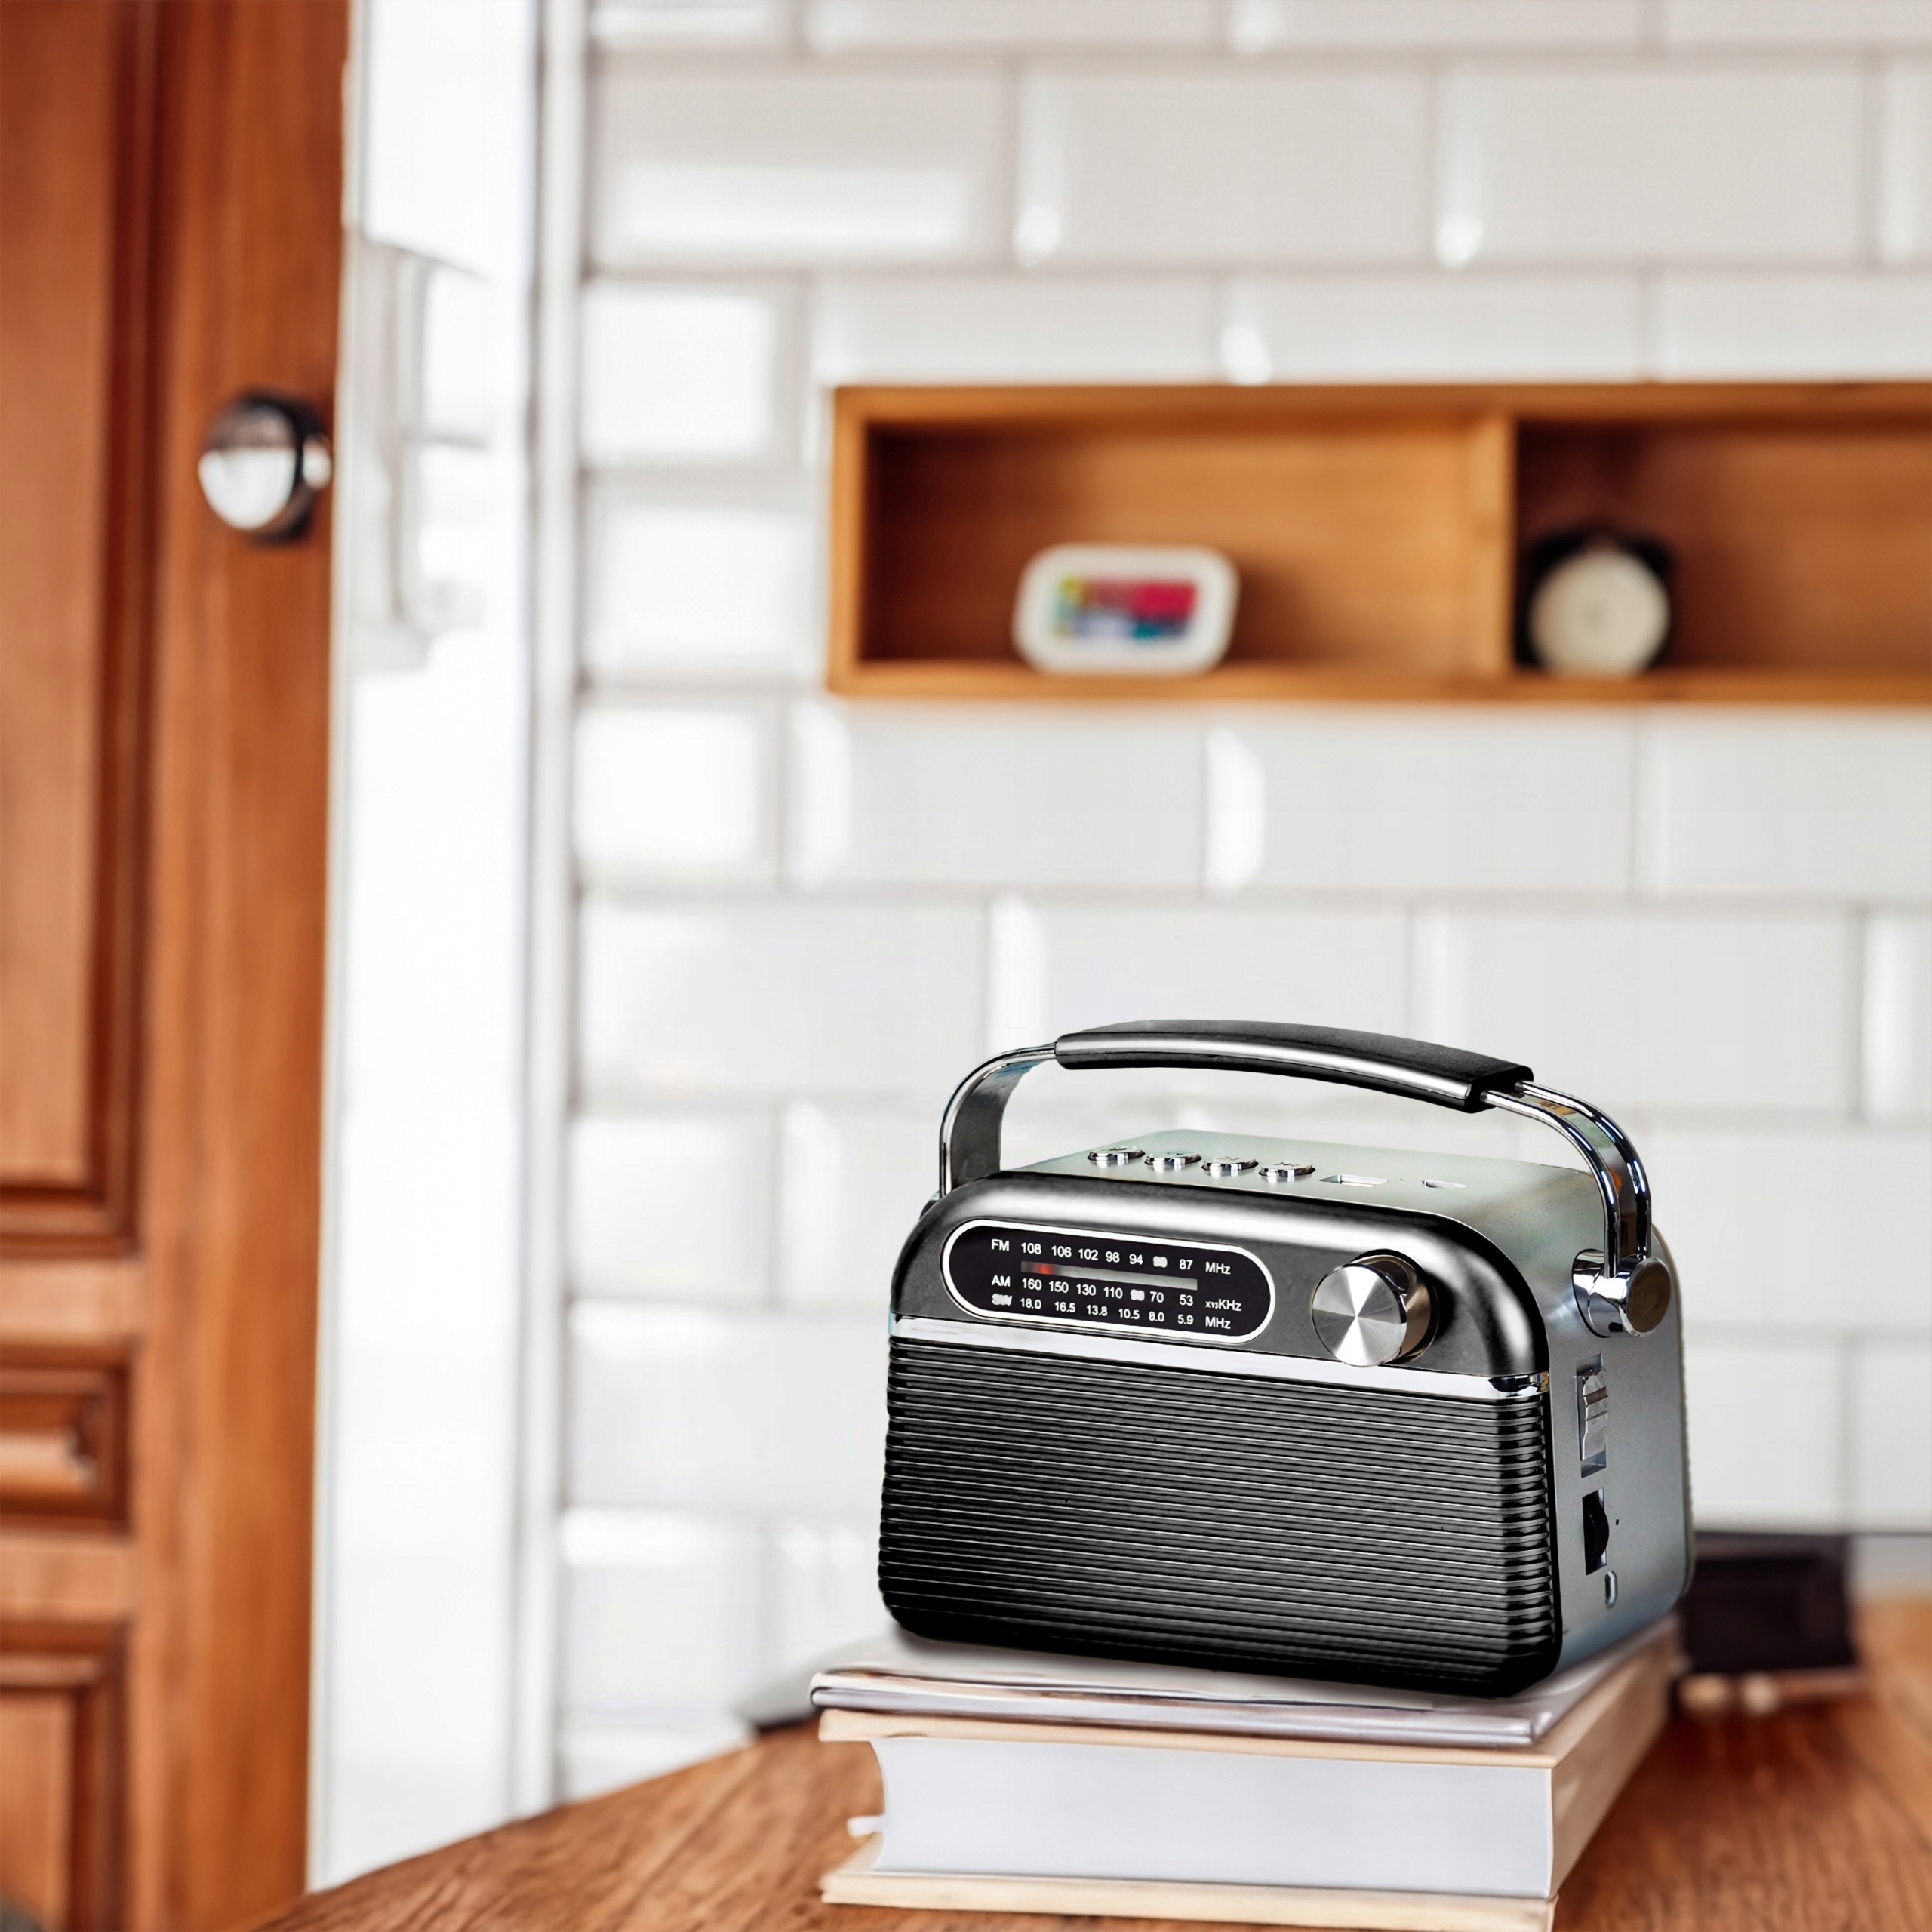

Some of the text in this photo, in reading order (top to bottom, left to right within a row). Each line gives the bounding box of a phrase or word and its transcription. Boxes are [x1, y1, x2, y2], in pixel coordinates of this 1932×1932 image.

[991, 1238, 1010, 1252] FM
[1020, 1242, 1042, 1255] 108
[1051, 1245, 1072, 1258] 106
[1078, 1248, 1099, 1261] 102
[1105, 1251, 1121, 1263] 98
[1128, 1253, 1143, 1266] 94
[1179, 1258, 1193, 1270] 87
[1205, 1261, 1232, 1275] MHz
[991, 1274, 1011, 1287] AM
[1021, 1278, 1042, 1291] 160
[1048, 1280, 1069, 1294] 150
[1075, 1283, 1097, 1296] 130
[1103, 1286, 1124, 1300] 110
[1149, 1291, 1164, 1303] 70
[1179, 1294, 1194, 1306] 53
[1020, 1297, 1042, 1309] 18.0
[1054, 1301, 1076, 1313] 16.5
[1118, 1308, 1140, 1320] 10.5
[1148, 1310, 1165, 1322] 8.0
[1177, 1313, 1194, 1325] 5.9
[1205, 1315, 1231, 1330] MHz
